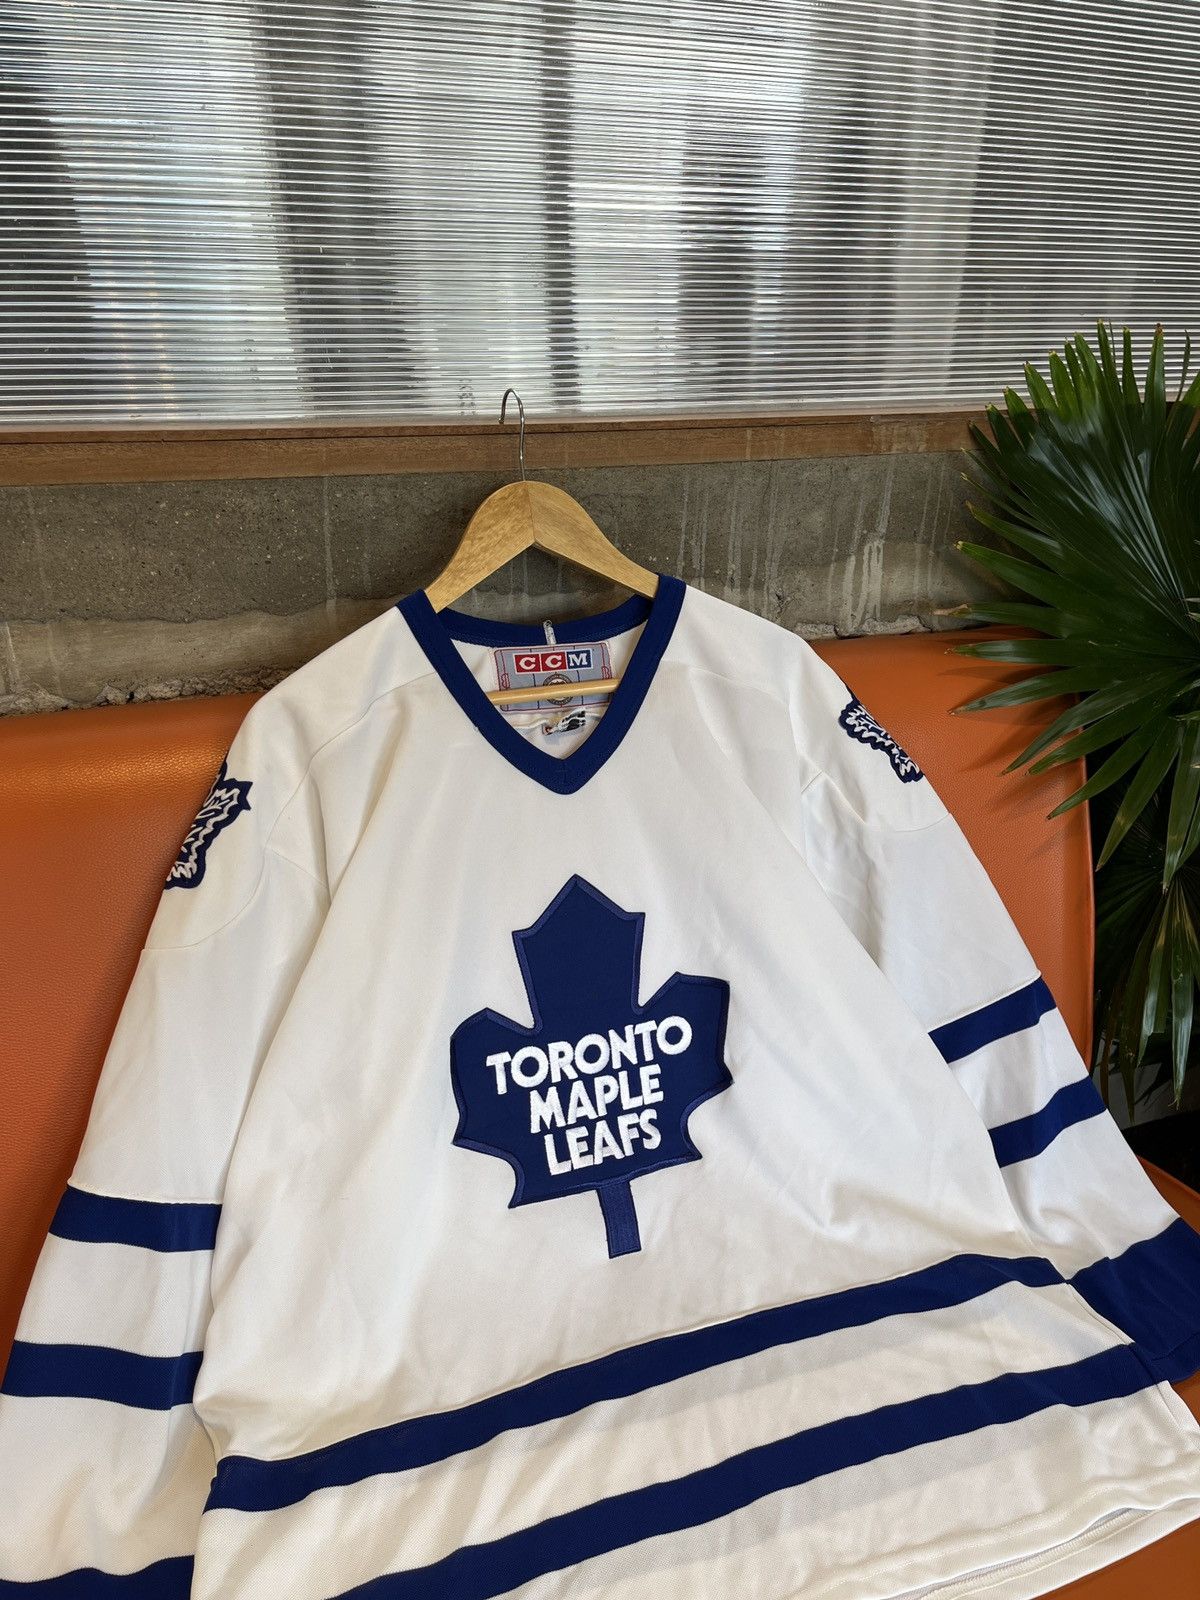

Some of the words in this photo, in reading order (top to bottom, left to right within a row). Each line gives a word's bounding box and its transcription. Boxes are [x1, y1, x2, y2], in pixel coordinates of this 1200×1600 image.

[519, 653, 588, 671] CCM
[486, 1015, 693, 1095] TORONTO
[530, 1065, 663, 1134] MAPLE
[544, 1109, 661, 1176] LEAFS
